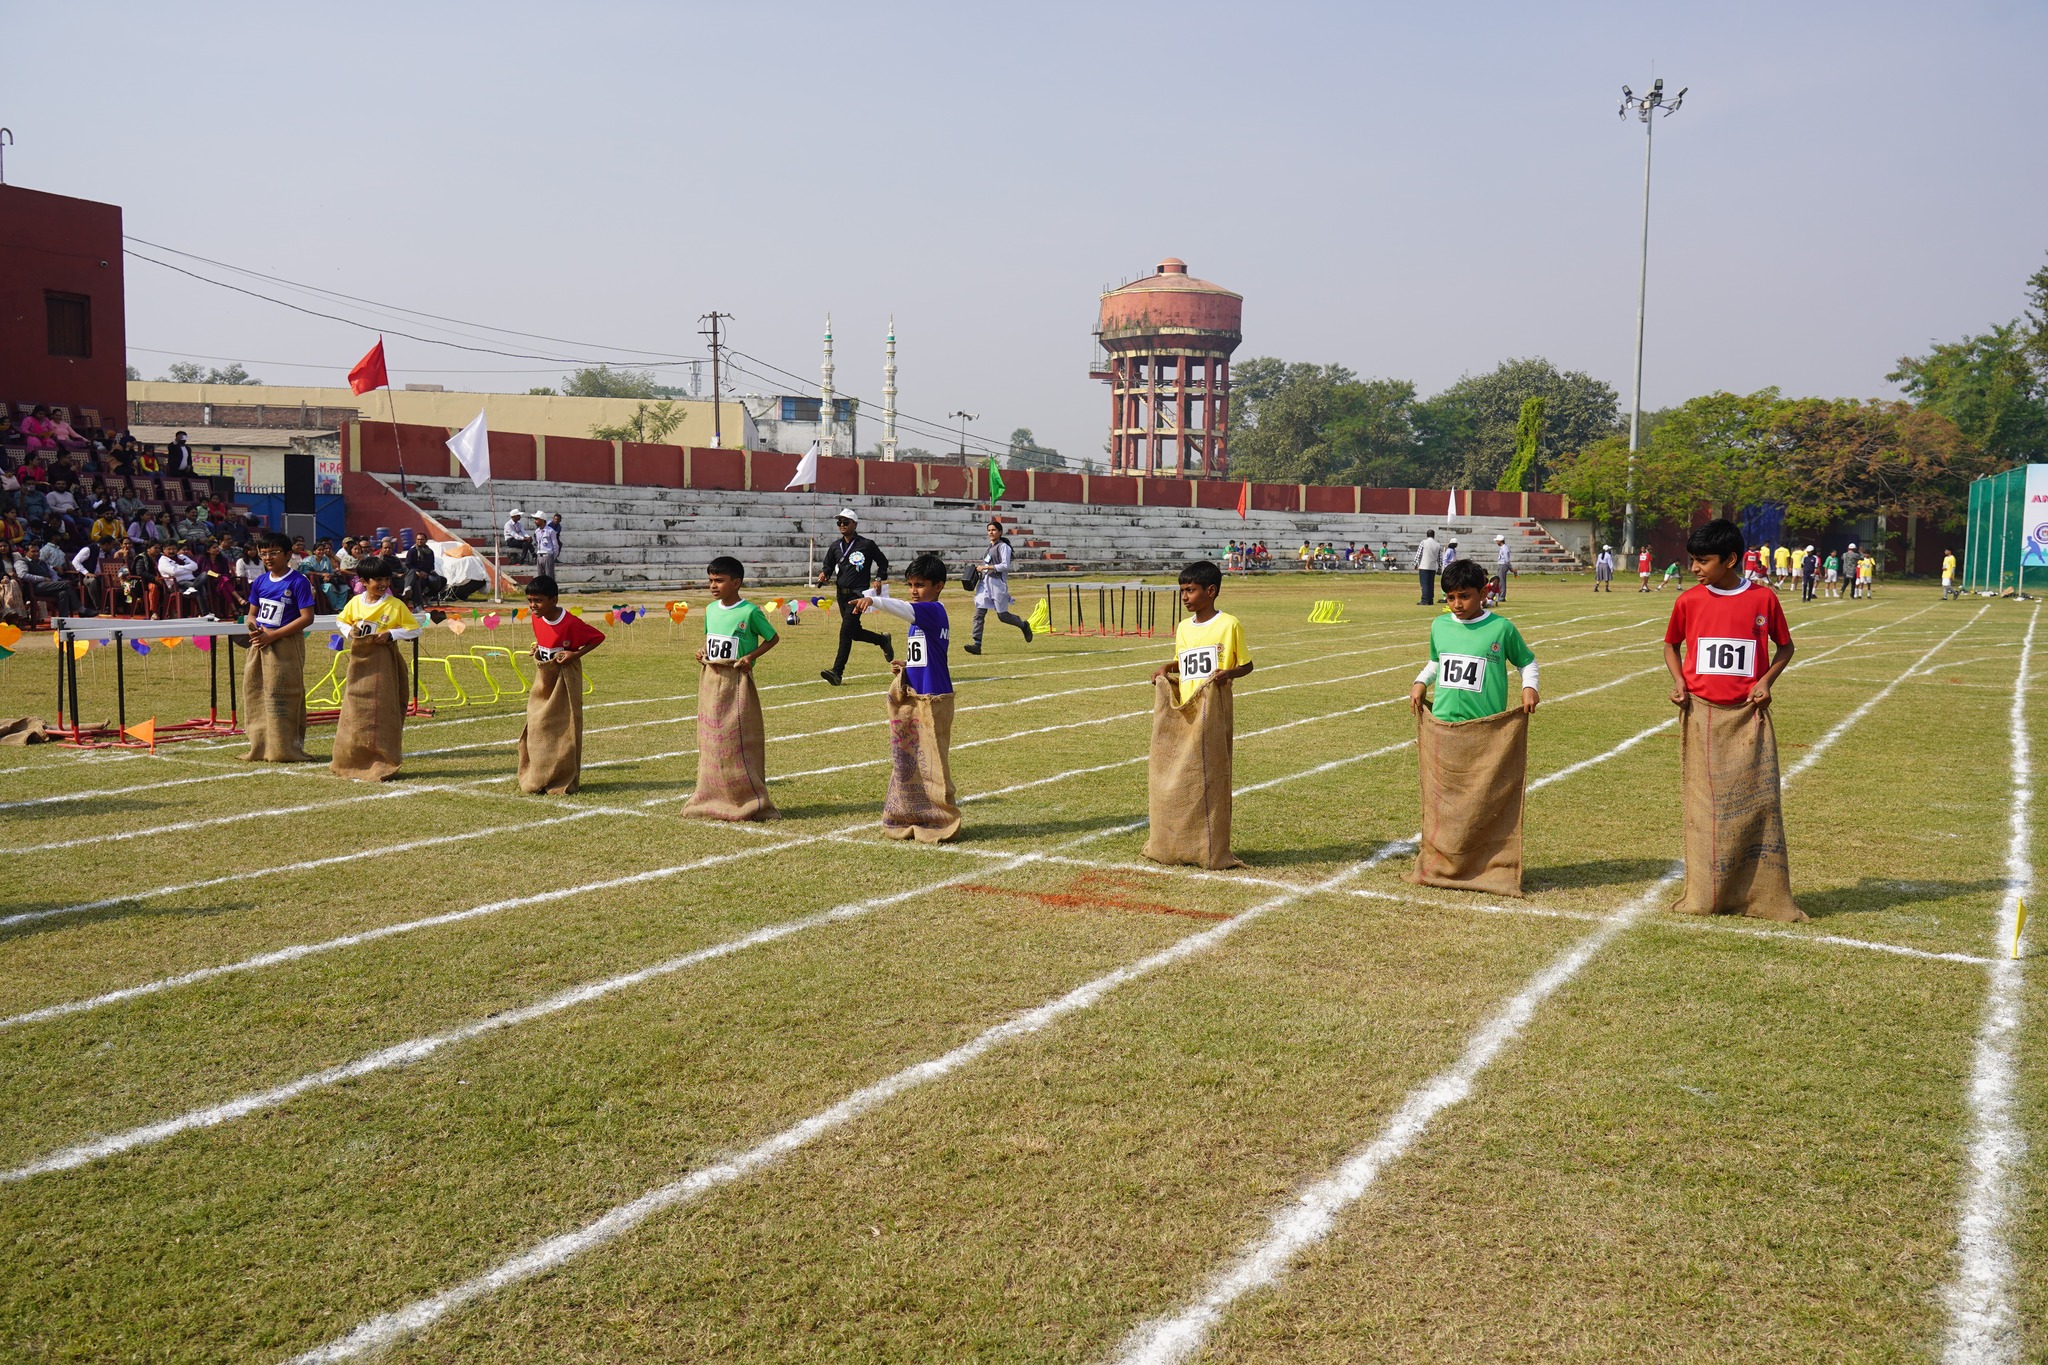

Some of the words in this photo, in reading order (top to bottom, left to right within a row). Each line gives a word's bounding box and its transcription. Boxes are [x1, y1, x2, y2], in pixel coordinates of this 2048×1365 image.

[259, 602, 278, 620] 157
[708, 638, 732, 659] 158
[1706, 643, 1746, 670] 161
[1183, 651, 1212, 677] 155
[1443, 658, 1478, 686] 154
